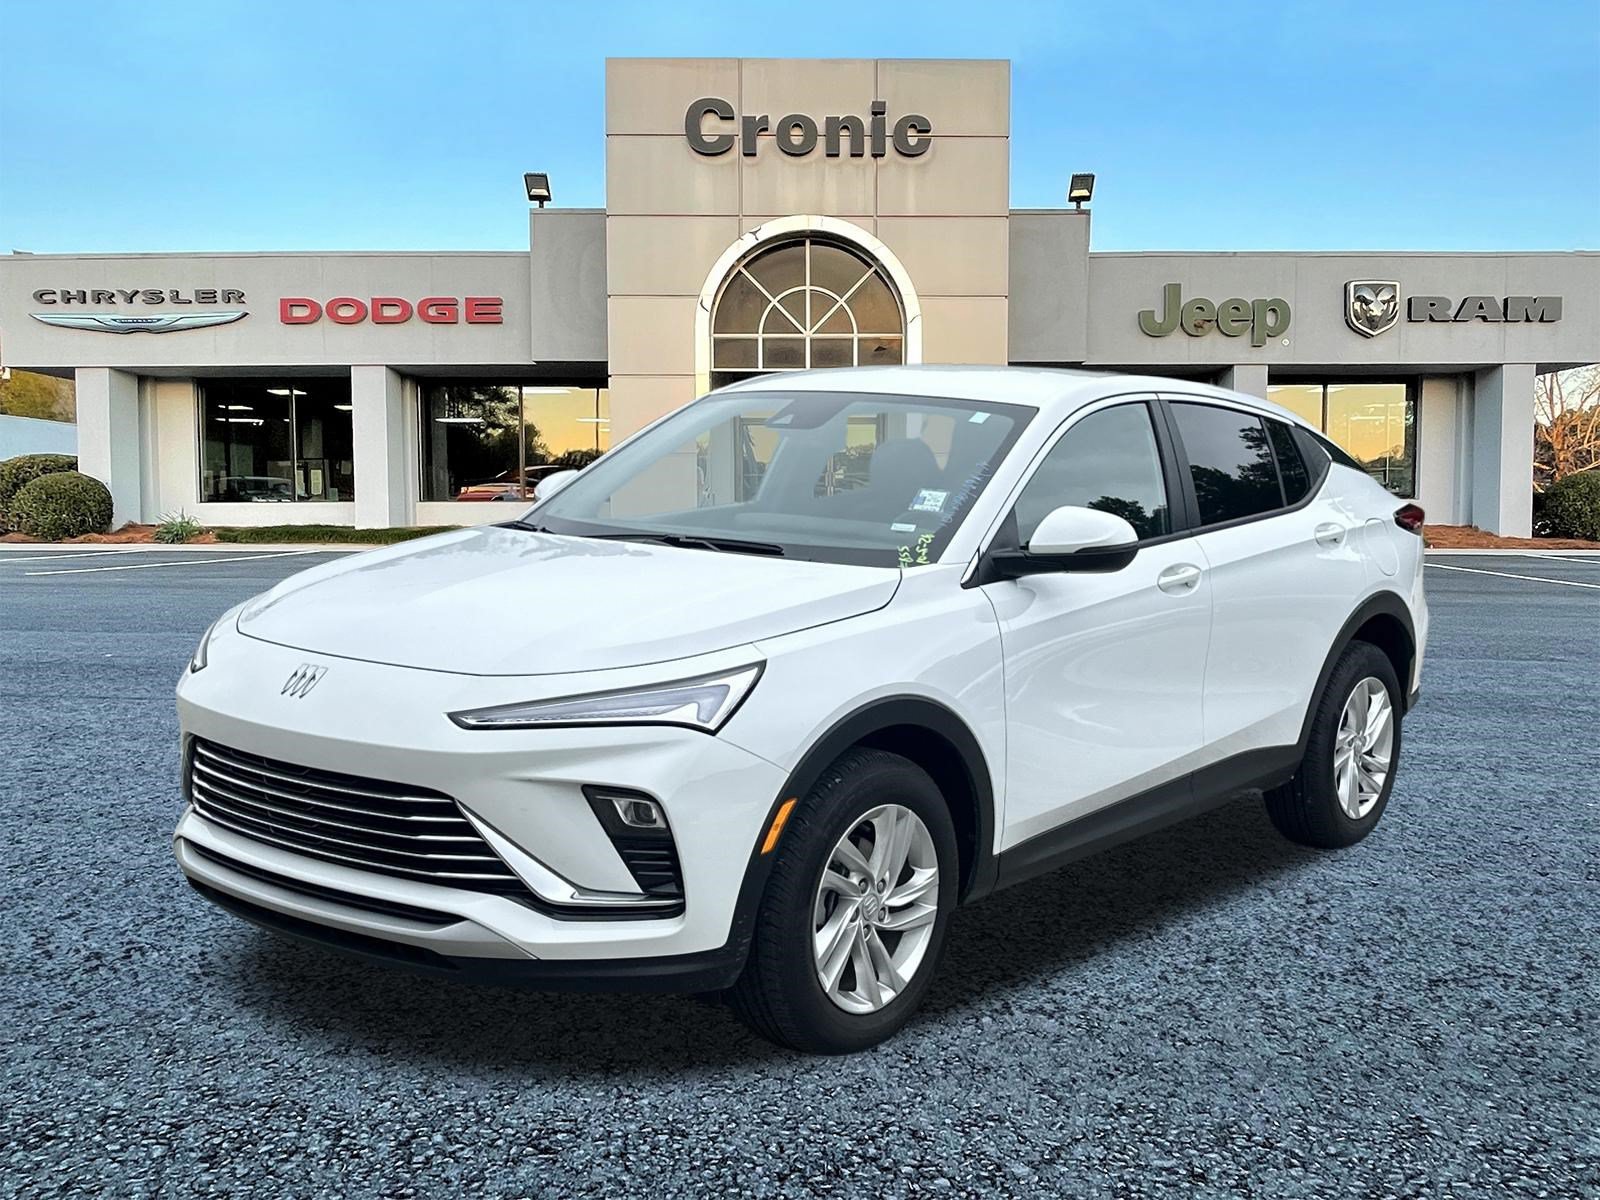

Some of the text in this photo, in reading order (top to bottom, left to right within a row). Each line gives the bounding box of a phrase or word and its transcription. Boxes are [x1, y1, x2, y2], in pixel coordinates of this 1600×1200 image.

[684, 98, 932, 158] Cronic
[32, 288, 247, 305] CHRYSLER
[1407, 296, 1563, 323] RAM
[280, 297, 504, 325] DODGE
[1138, 283, 1291, 347] Jeep
